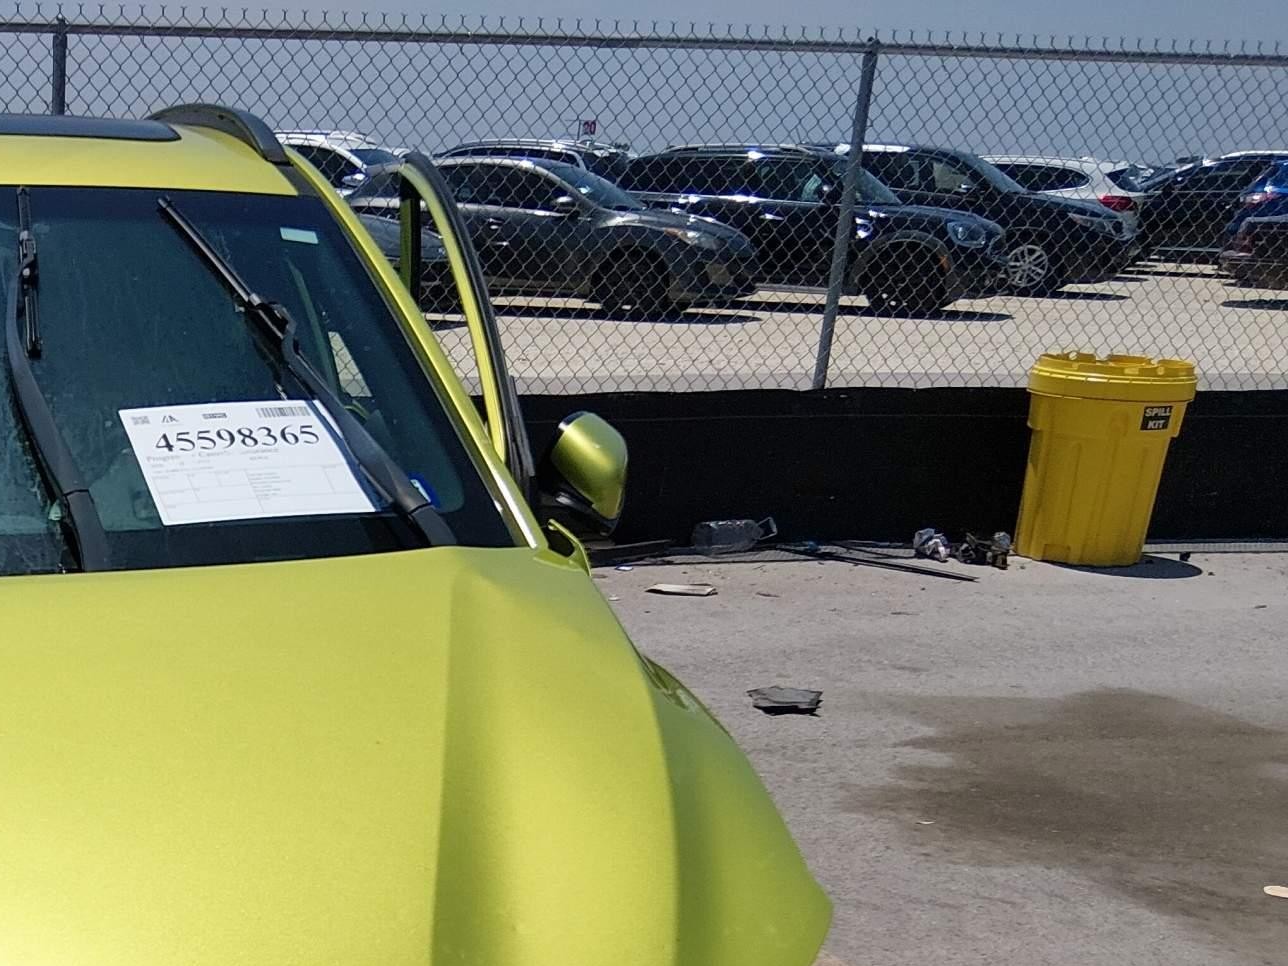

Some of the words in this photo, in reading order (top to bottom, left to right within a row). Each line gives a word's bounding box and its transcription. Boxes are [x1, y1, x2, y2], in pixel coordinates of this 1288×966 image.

[1145, 407, 1172, 417] SPILL
[1147, 420, 1167, 429] KIT
[155, 424, 321, 453] 45598365
